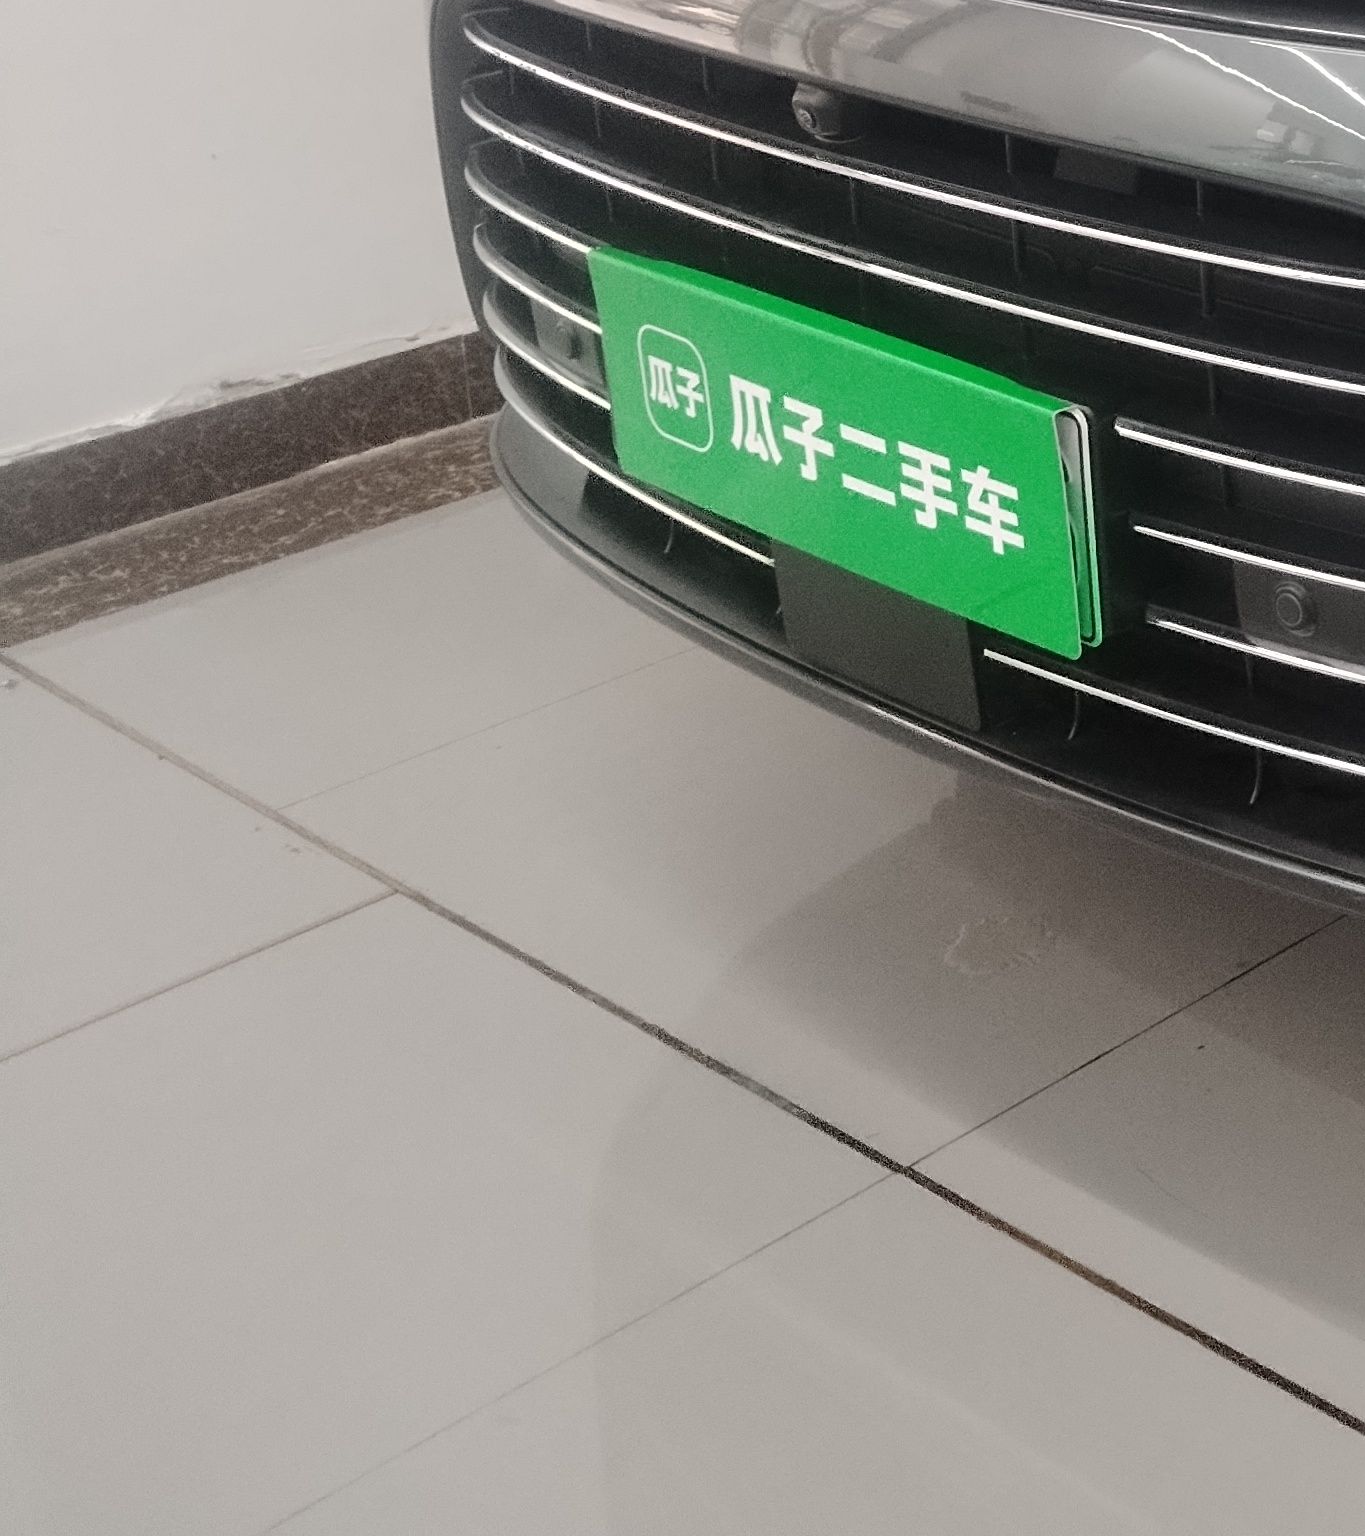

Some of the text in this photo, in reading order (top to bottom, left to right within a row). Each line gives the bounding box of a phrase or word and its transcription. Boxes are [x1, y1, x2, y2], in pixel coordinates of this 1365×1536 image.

[647, 355, 704, 417] 瓜子
[729, 375, 1025, 555] 瓜子二手车
